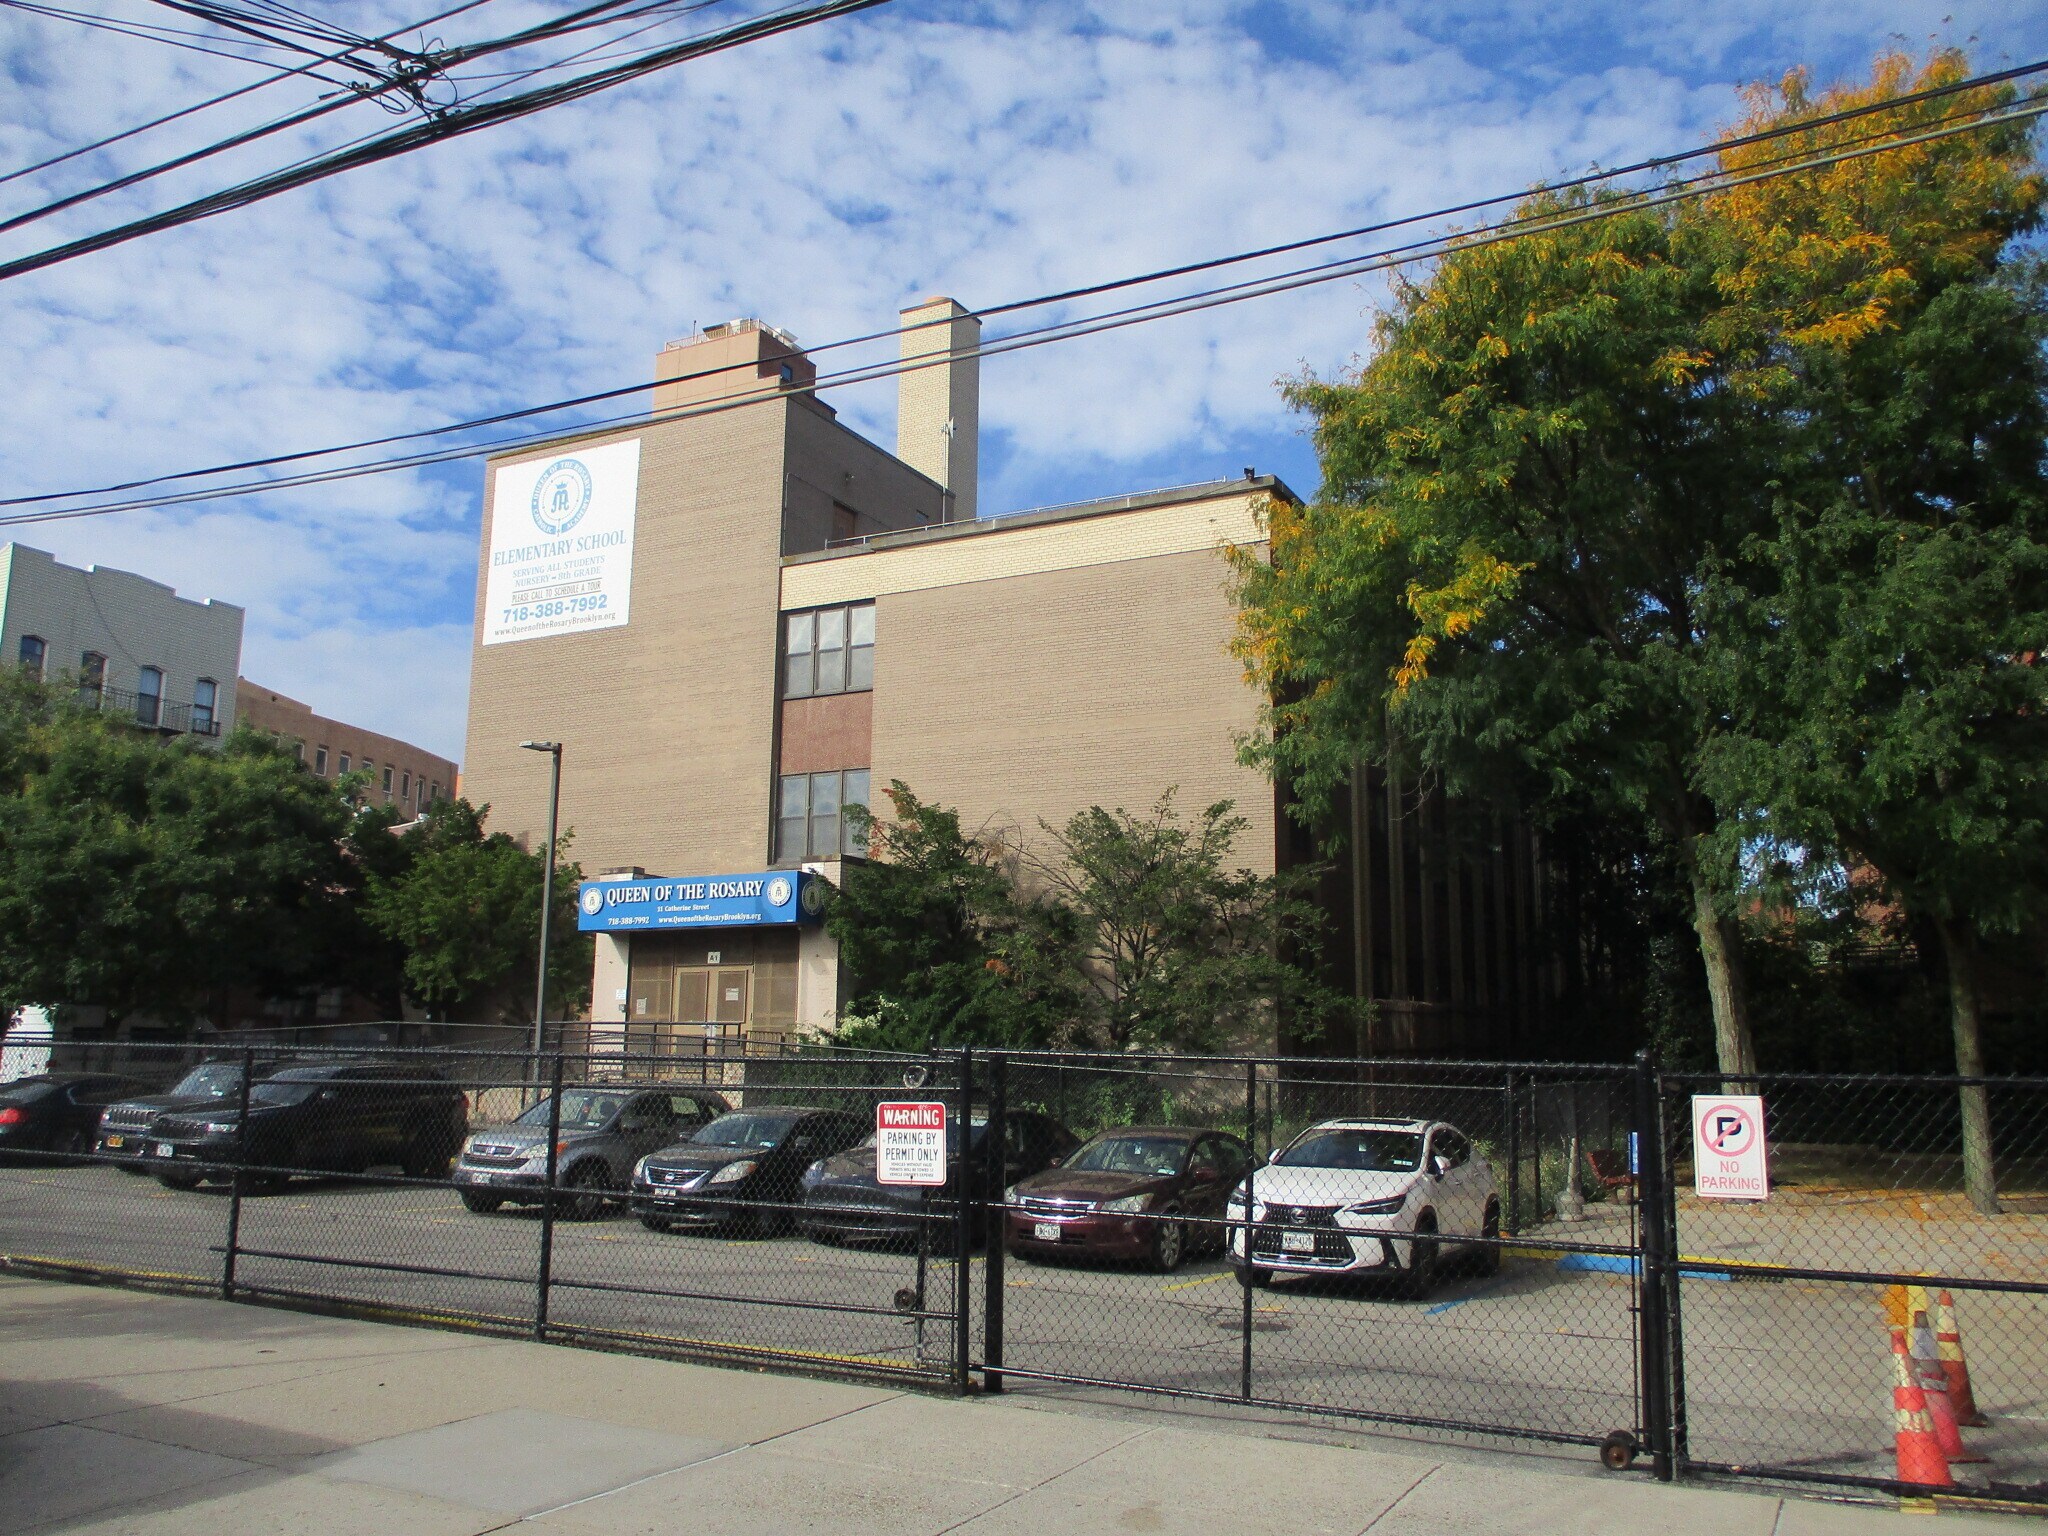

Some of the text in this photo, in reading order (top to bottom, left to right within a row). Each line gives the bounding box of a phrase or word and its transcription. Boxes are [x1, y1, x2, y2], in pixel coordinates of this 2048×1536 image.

[533, 472, 549, 500] QUEEN
[549, 465, 559, 474] OF
[573, 463, 591, 492] ROSARY
[534, 508, 554, 533] CATHOLIC
[567, 498, 590, 528] ACADEMY
[494, 530, 627, 566] ELEMENTARY SCHOOL
[512, 555, 605, 578] SERVING ALL STUDENTS
[515, 574, 551, 587] NURSERY
[558, 570, 571, 580] 8th
[573, 566, 601, 578] GRADE
[511, 592, 529, 603] PLEASE
[531, 590, 543, 599] CALL
[545, 588, 553, 597] TO
[554, 585, 580, 597] SCHEDULE
[587, 580, 601, 590] TOUR
[503, 594, 608, 624] 718-388-7992
[494, 611, 616, 636] www.QueenoftheRosaryBrooklyn.org
[606, 886, 651, 907] QUEEN
[654, 885, 673, 901] OF
[677, 883, 705, 900] THE
[709, 880, 765, 898] ROSARY
[658, 913, 762, 925] www.QueenoftheRosaryBrooklyn.org
[664, 904, 691, 912] Catherine
[608, 916, 650, 926] 718-388-7992
[883, 1109, 940, 1126] WARNING
[887, 1131, 937, 1145] PARKING BY
[885, 1147, 939, 1161] PERMIT ONLY
[1720, 1160, 1739, 1173] NO
[1701, 1176, 1761, 1190] PARKING
